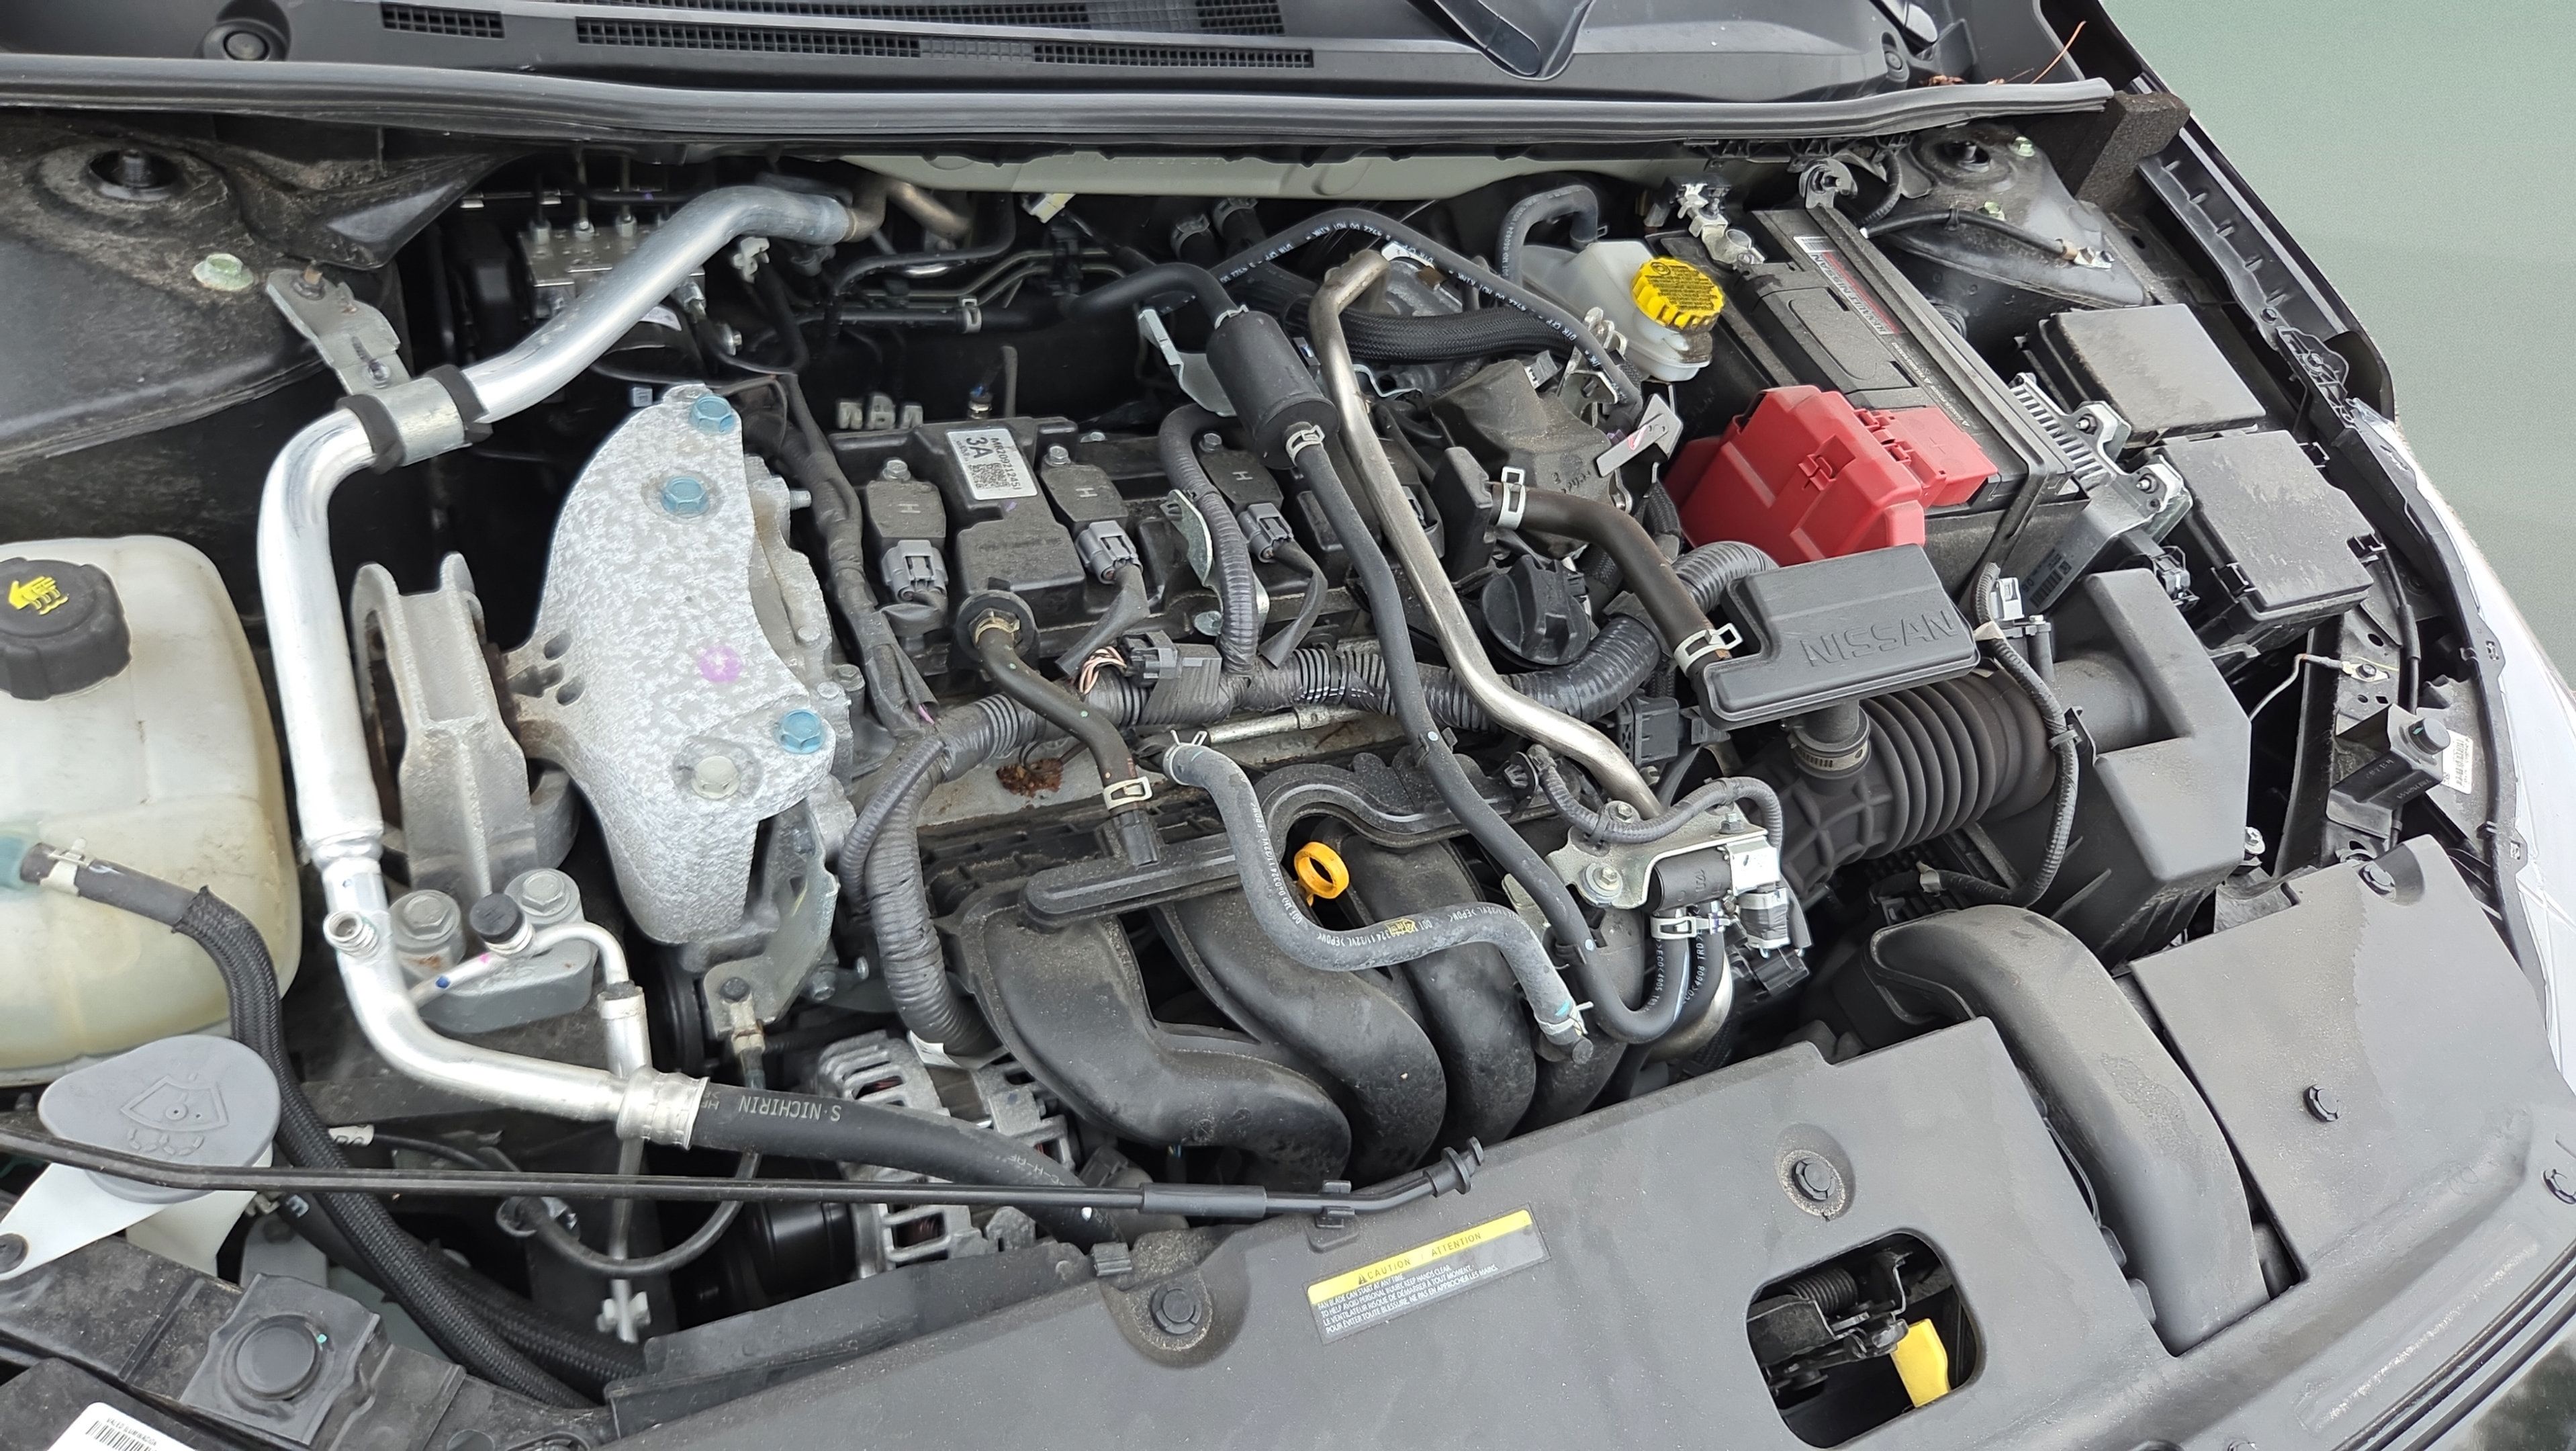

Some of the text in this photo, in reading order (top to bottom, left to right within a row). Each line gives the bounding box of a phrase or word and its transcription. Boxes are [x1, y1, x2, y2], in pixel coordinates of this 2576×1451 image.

[966, 437, 993, 459] 3A
[1800, 610, 1957, 667] NISSAN
[1367, 1258, 1411, 1279] CAUTION
[1430, 1231, 1481, 1256] ATTENTION
[1325, 1321, 1344, 1333] POUR
[1361, 1308, 1381, 1320] TOUTE
[1417, 1290, 1428, 1299] PAS
[1436, 1274, 1469, 1292] APPROCHER
[1468, 1270, 1479, 1280] LES
[1328, 1304, 1342, 1315] HELP
[1342, 1298, 1360, 1309] AVOID
[1359, 1288, 1385, 1303] PERSONAL
[1403, 1276, 1417, 1286] KEEP
[1416, 1270, 1434, 1282] HANDS
[1330, 1304, 1368, 1323] VENTILATEUR
[1367, 1296, 1389, 1309] RISQUE
[1431, 1274, 1446, 1285] TOUT
[1345, 1290, 1359, 1299] CAN
[1357, 1284, 1374, 1295] START
